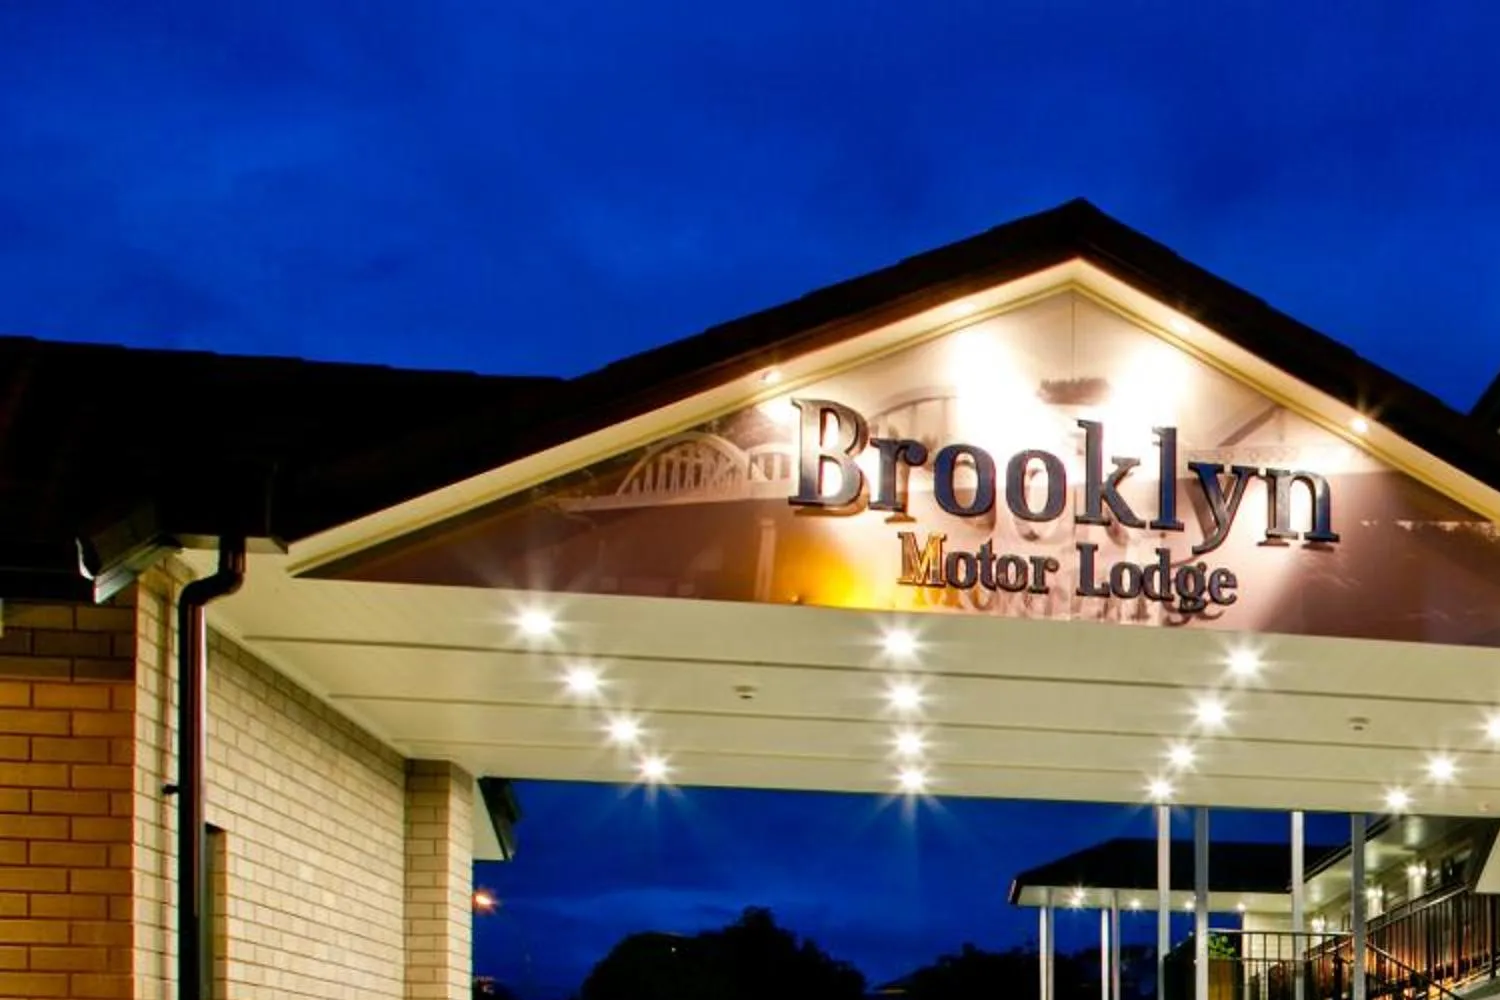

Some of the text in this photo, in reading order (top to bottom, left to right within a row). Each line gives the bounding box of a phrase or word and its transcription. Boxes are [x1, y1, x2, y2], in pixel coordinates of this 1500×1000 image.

[788, 397, 1340, 554] Brooklyn
[897, 530, 1238, 613] Motor Lodge
